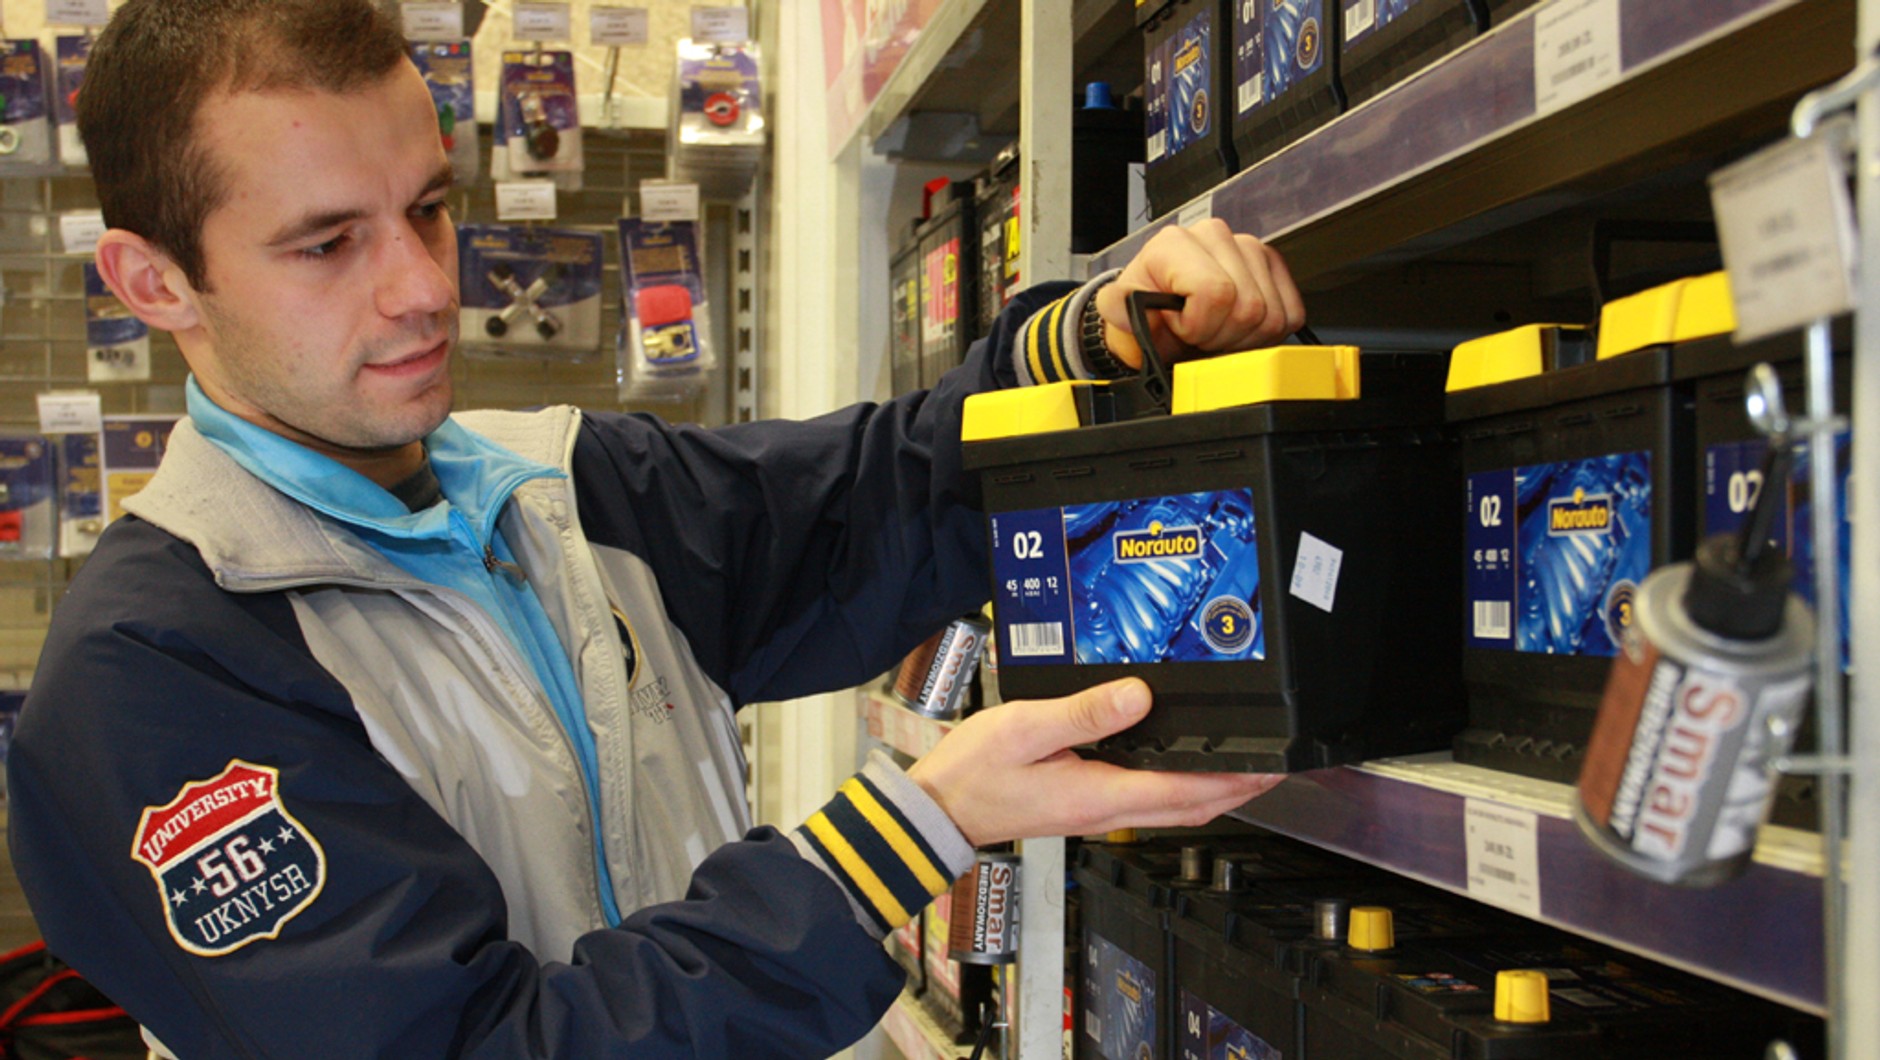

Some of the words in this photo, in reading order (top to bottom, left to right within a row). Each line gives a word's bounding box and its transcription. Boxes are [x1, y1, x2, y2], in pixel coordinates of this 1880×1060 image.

[1303, 35, 1312, 52] 3
[1480, 495, 1502, 528] 02
[1552, 506, 1608, 529] Norauto
[1013, 530, 1044, 559] 02
[1120, 535, 1197, 558] Norauto
[1006, 579, 1018, 591] 45
[1024, 577, 1041, 590] 400
[1047, 576, 1058, 588] 12
[1221, 615, 1235, 634] 3
[1619, 603, 1632, 627] 3
[1643, 684, 1738, 850] Smar
[143, 776, 268, 863] UNIVERSITY
[197, 834, 267, 898] 56
[195, 863, 311, 943] UKNYSR
[974, 864, 990, 951] MIEDZIOWANY
[986, 866, 1012, 951] Smar
[1188, 1010, 1200, 1039] 04
